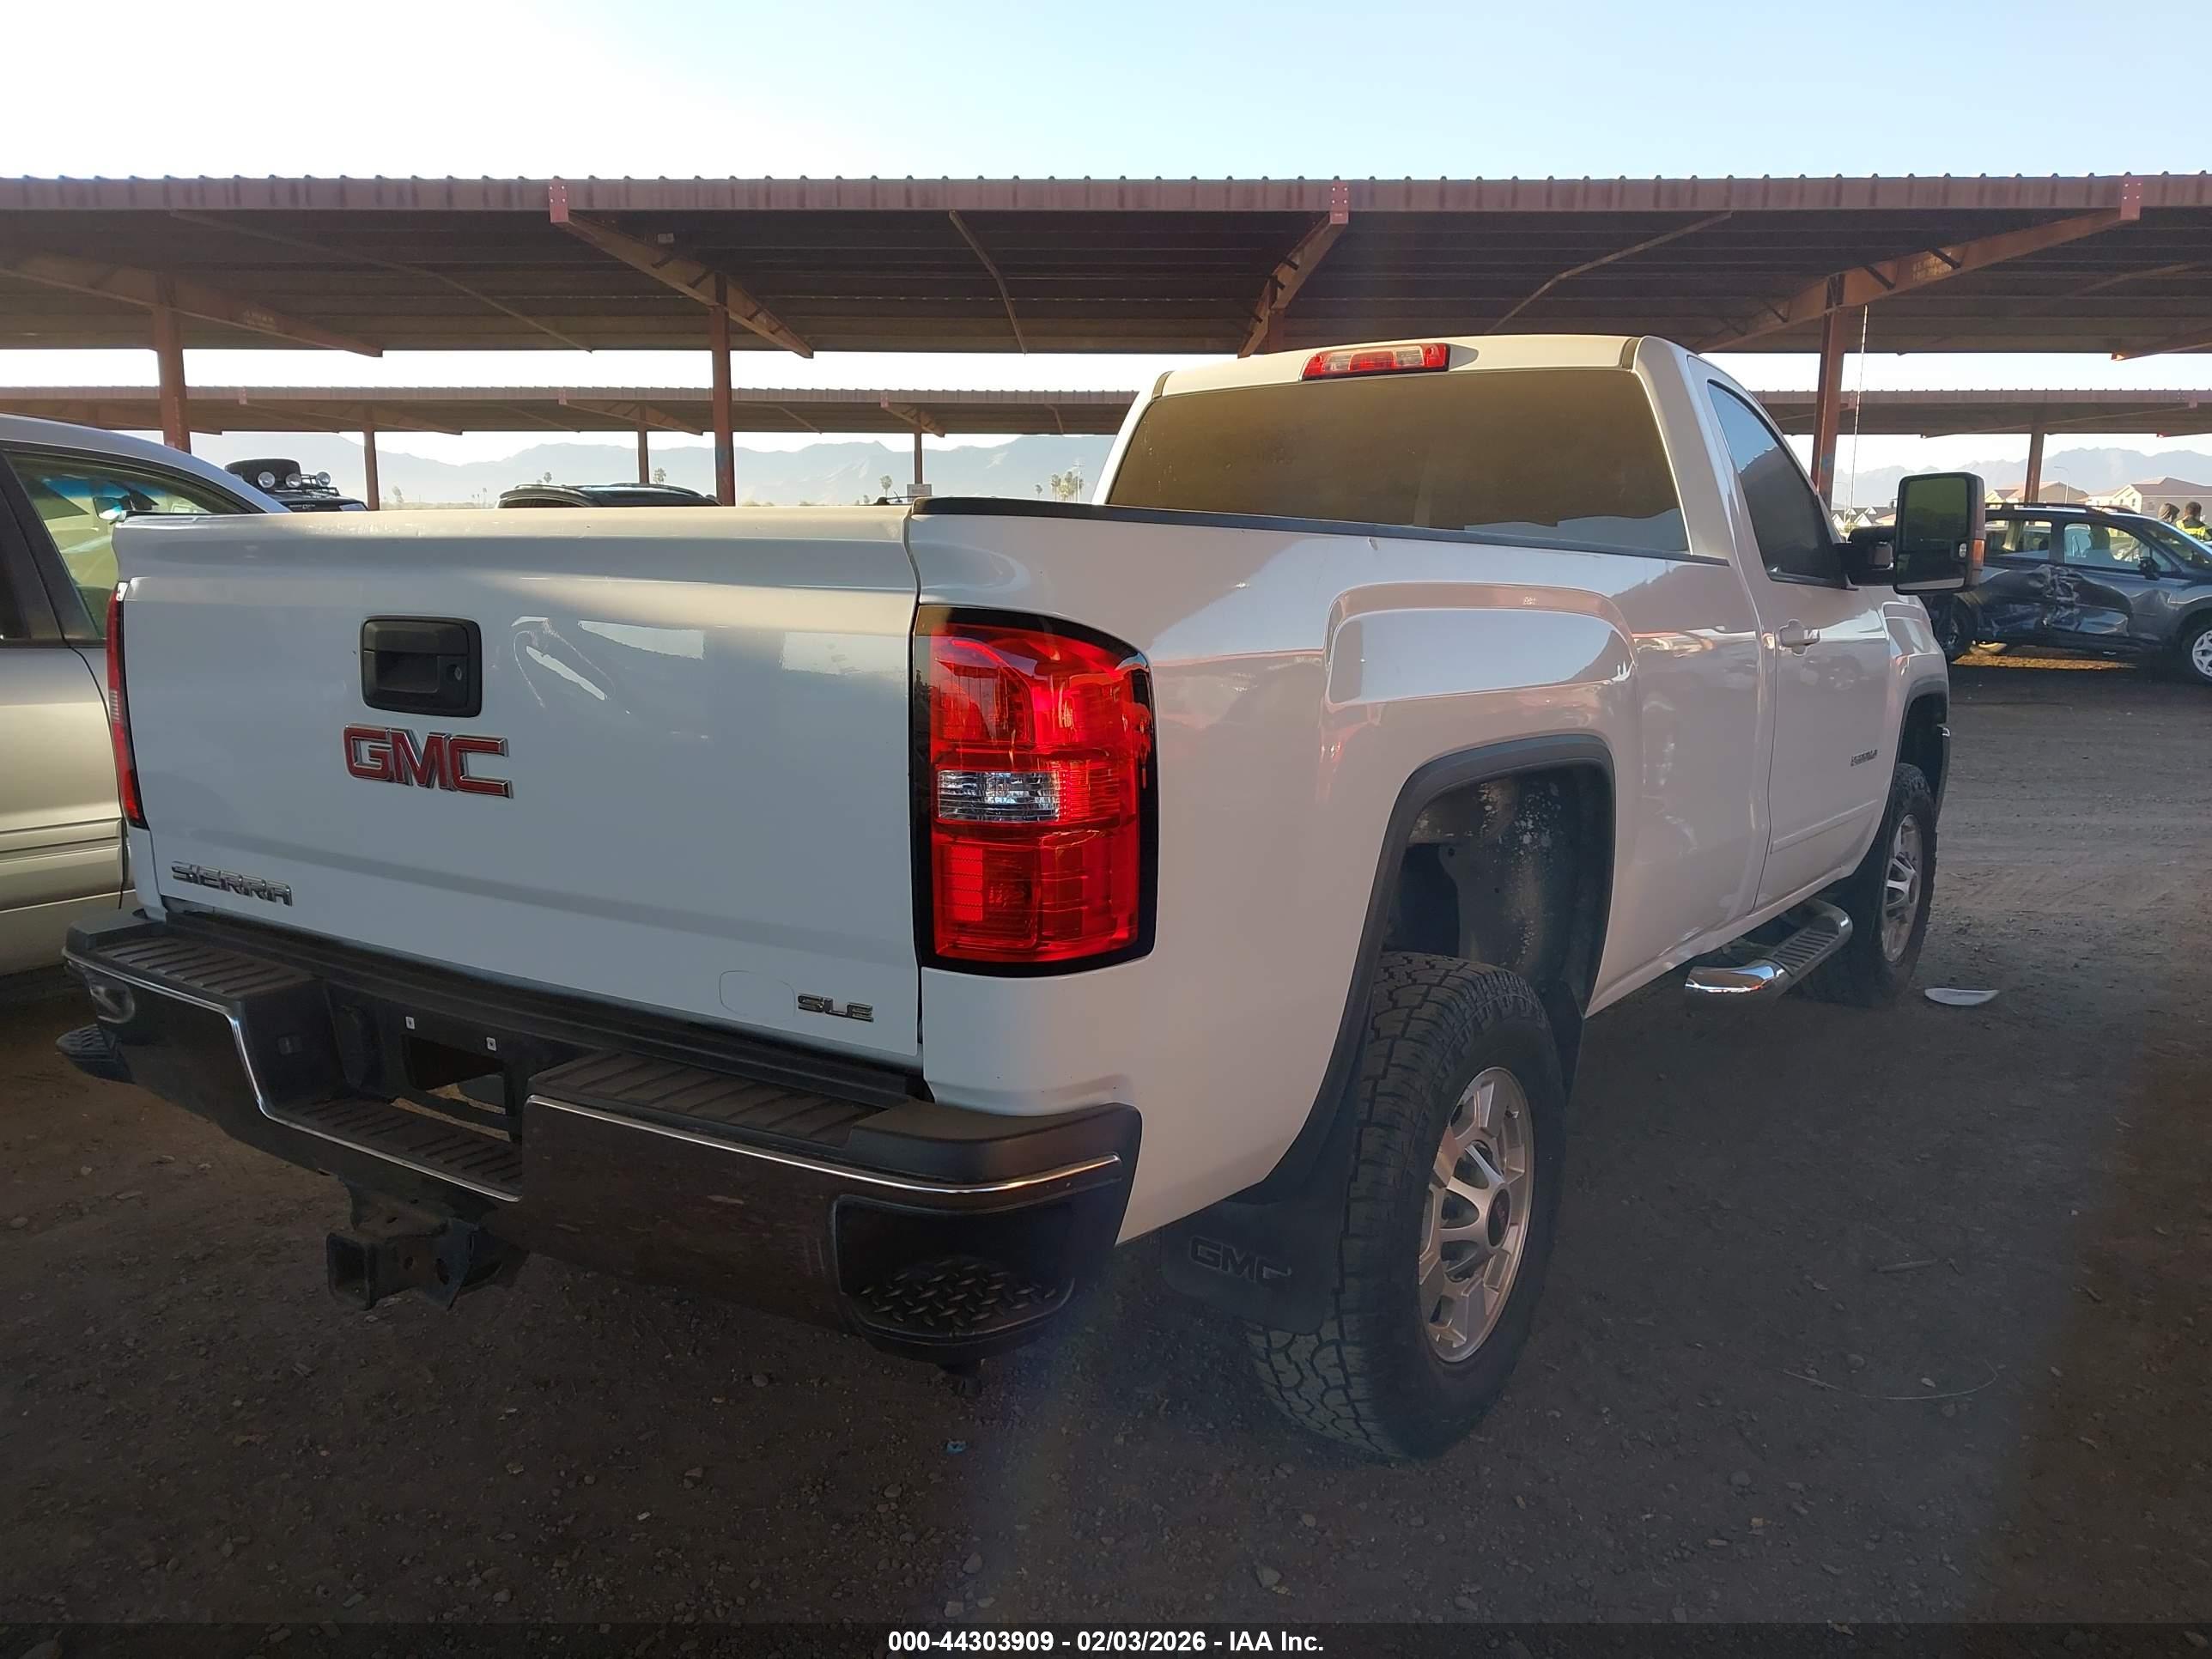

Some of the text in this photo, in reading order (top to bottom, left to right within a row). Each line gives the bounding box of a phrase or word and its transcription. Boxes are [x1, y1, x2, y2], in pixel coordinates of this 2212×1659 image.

[343, 723, 514, 799] GMC
[171, 860, 293, 907] SIERRA
[797, 993, 874, 1023] SLE
